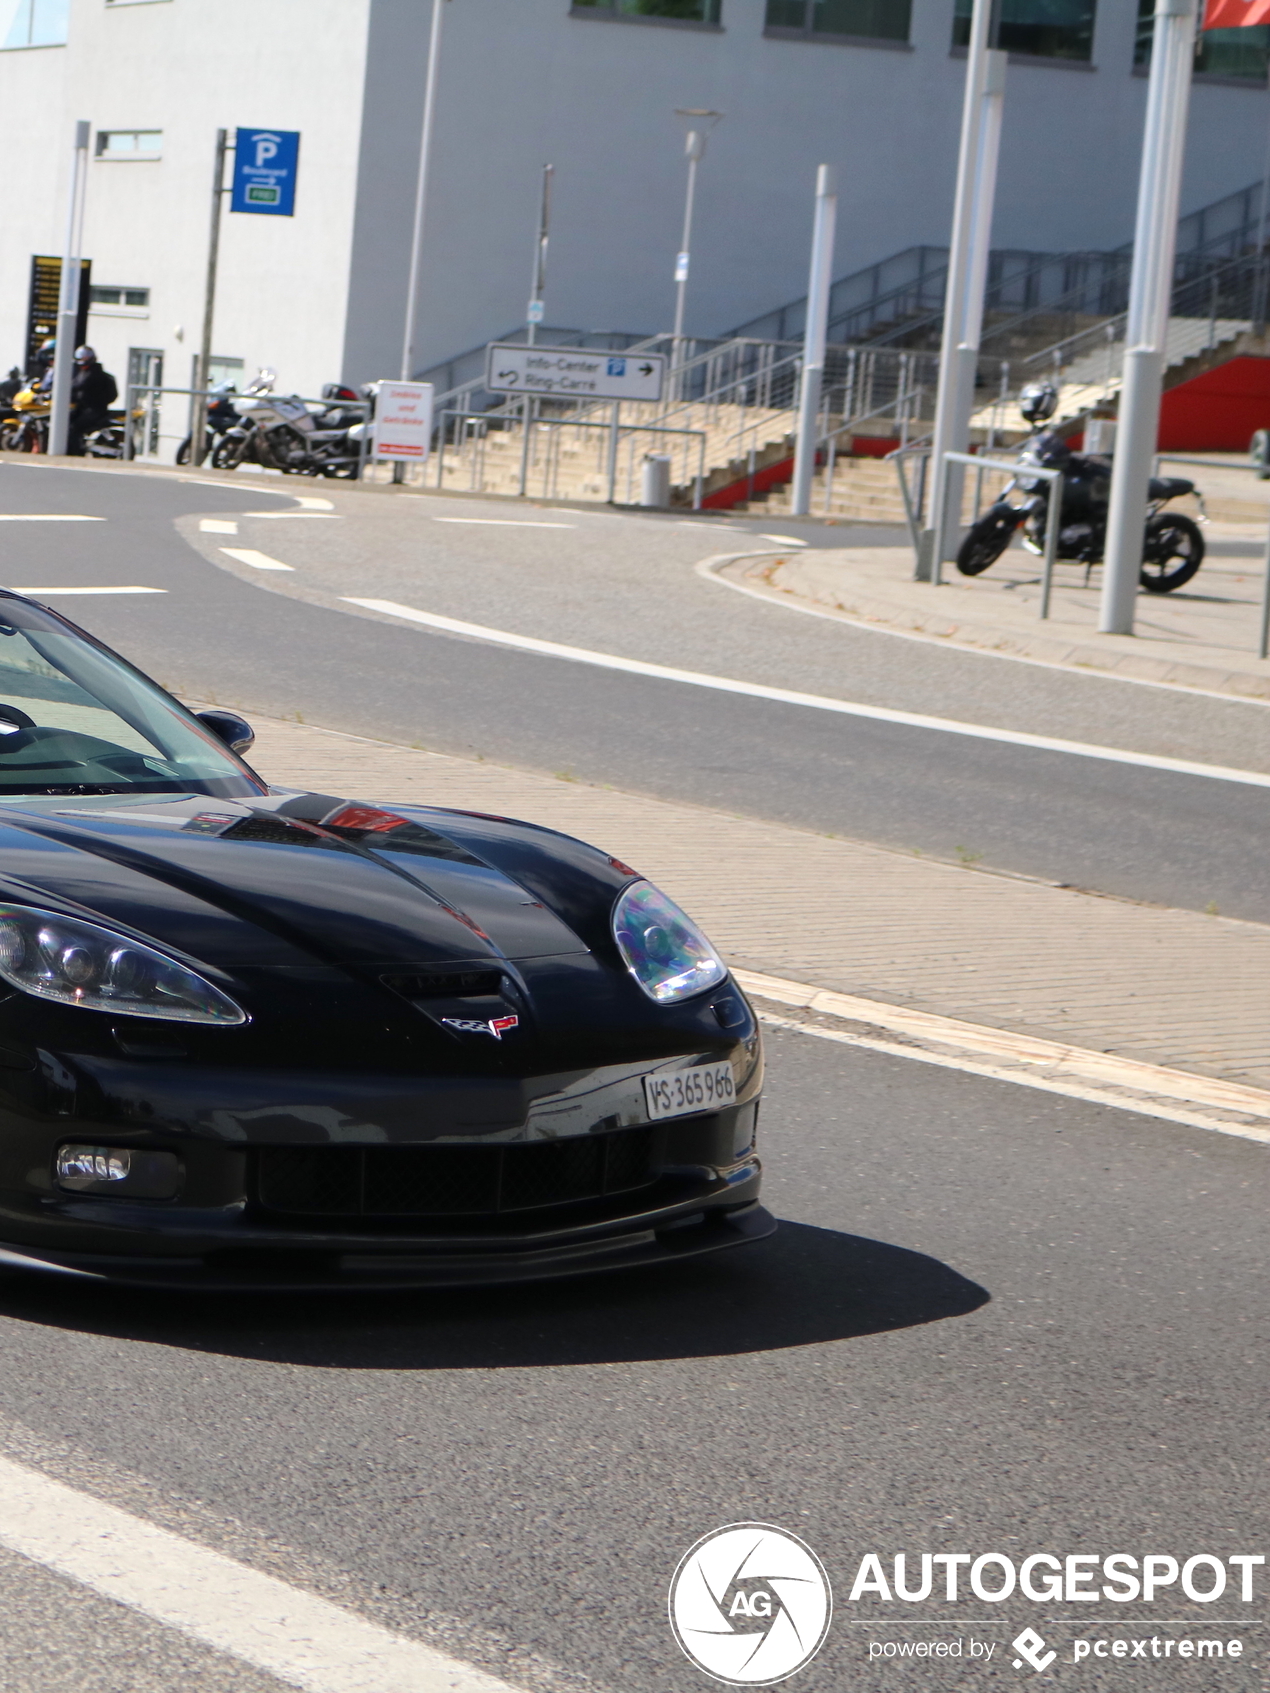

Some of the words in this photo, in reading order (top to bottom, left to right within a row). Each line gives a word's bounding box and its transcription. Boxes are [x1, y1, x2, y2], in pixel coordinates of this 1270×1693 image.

[256, 141, 278, 167] P
[526, 356, 601, 373] Info-Center
[524, 373, 597, 391] Ring-Carré
